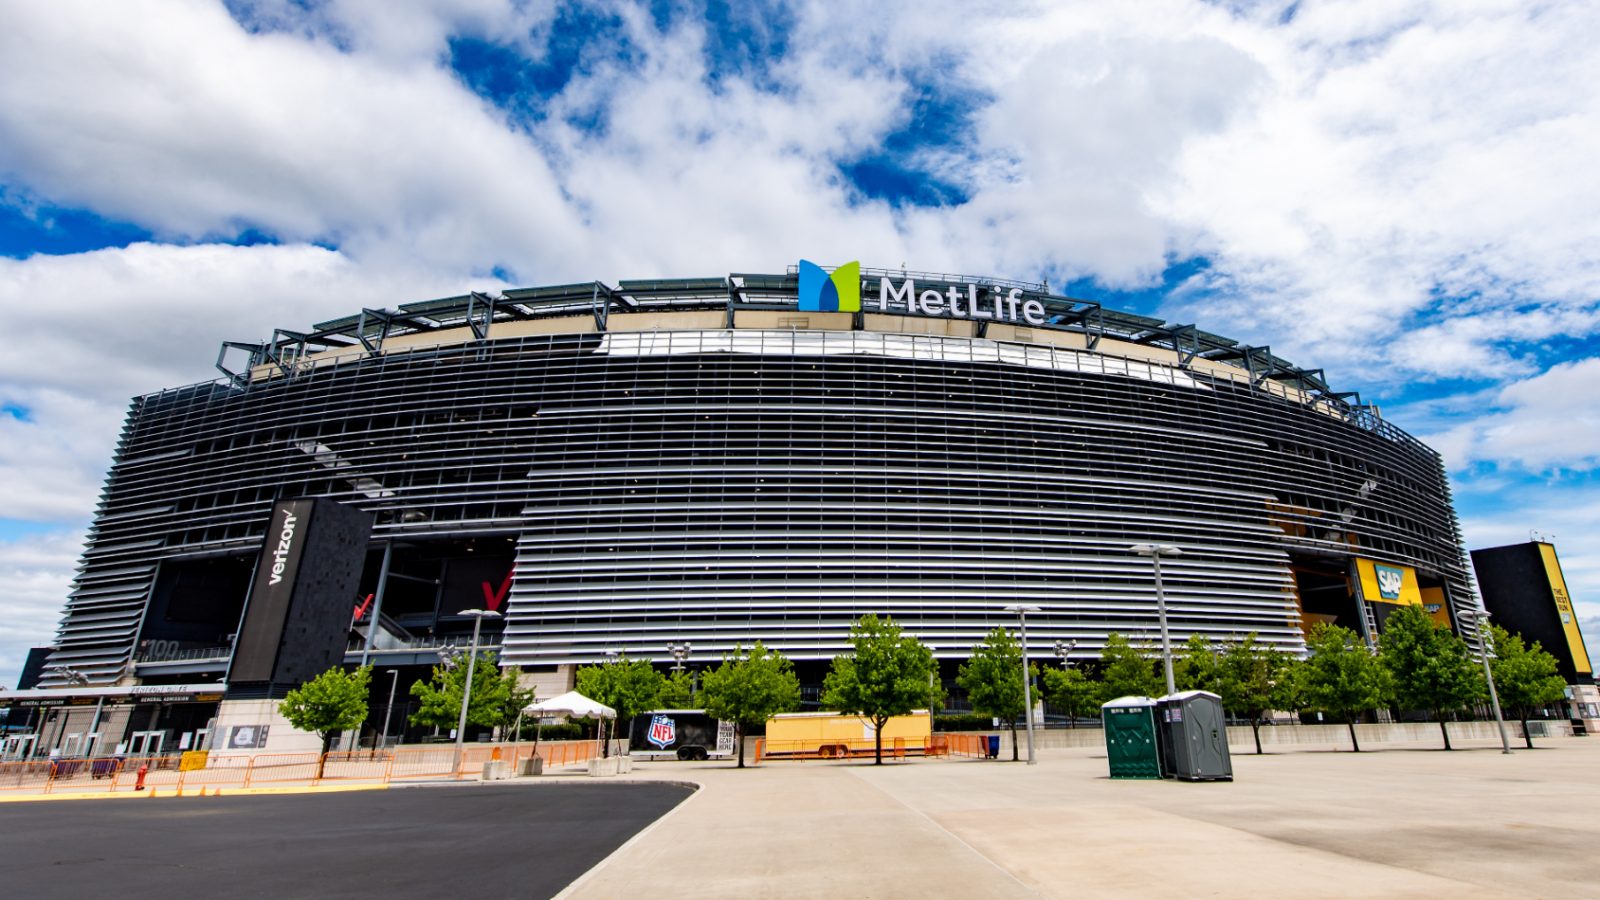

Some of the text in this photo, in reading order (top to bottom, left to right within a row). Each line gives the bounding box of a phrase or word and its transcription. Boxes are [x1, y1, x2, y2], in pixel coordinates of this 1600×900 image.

[879, 276, 1046, 325] MetLife
[268, 516, 297, 586] verizon
[1378, 570, 1401, 594] SAP
[147, 639, 179, 659] 100
[653, 724, 674, 741] NFL
